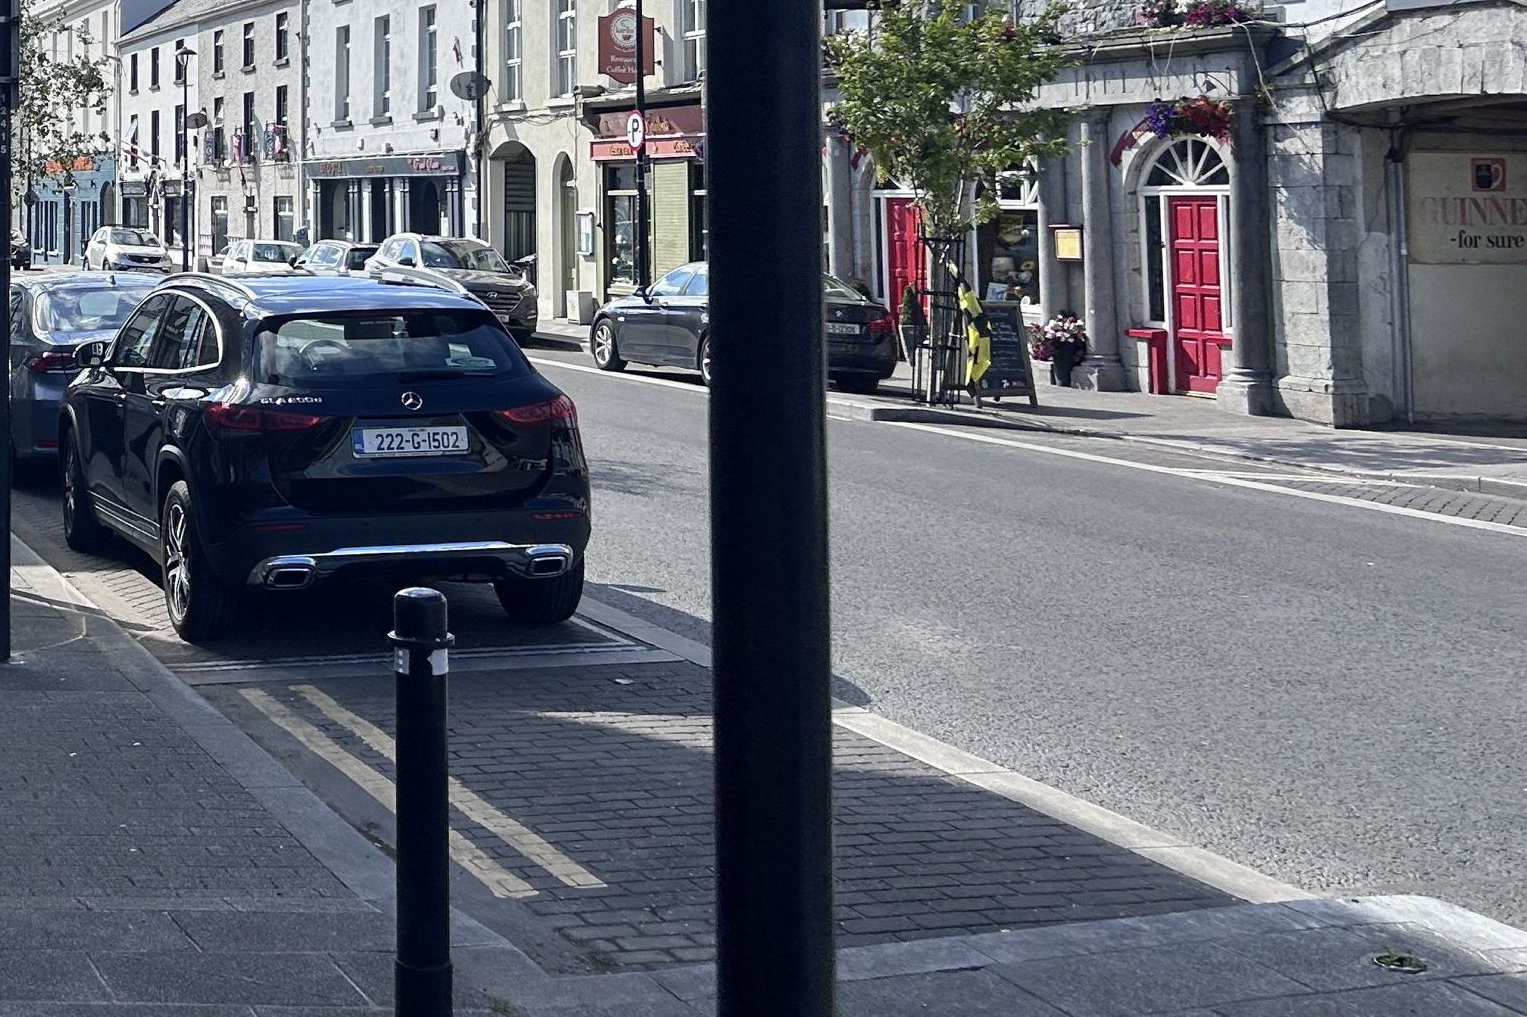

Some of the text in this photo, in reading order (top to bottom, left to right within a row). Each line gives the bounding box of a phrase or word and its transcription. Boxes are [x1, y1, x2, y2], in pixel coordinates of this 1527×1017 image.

[632, 118, 640, 143] P
[1486, 234, 1525, 249] sure
[260, 396, 287, 406] GLA
[376, 432, 460, 451] 222-G-1502
